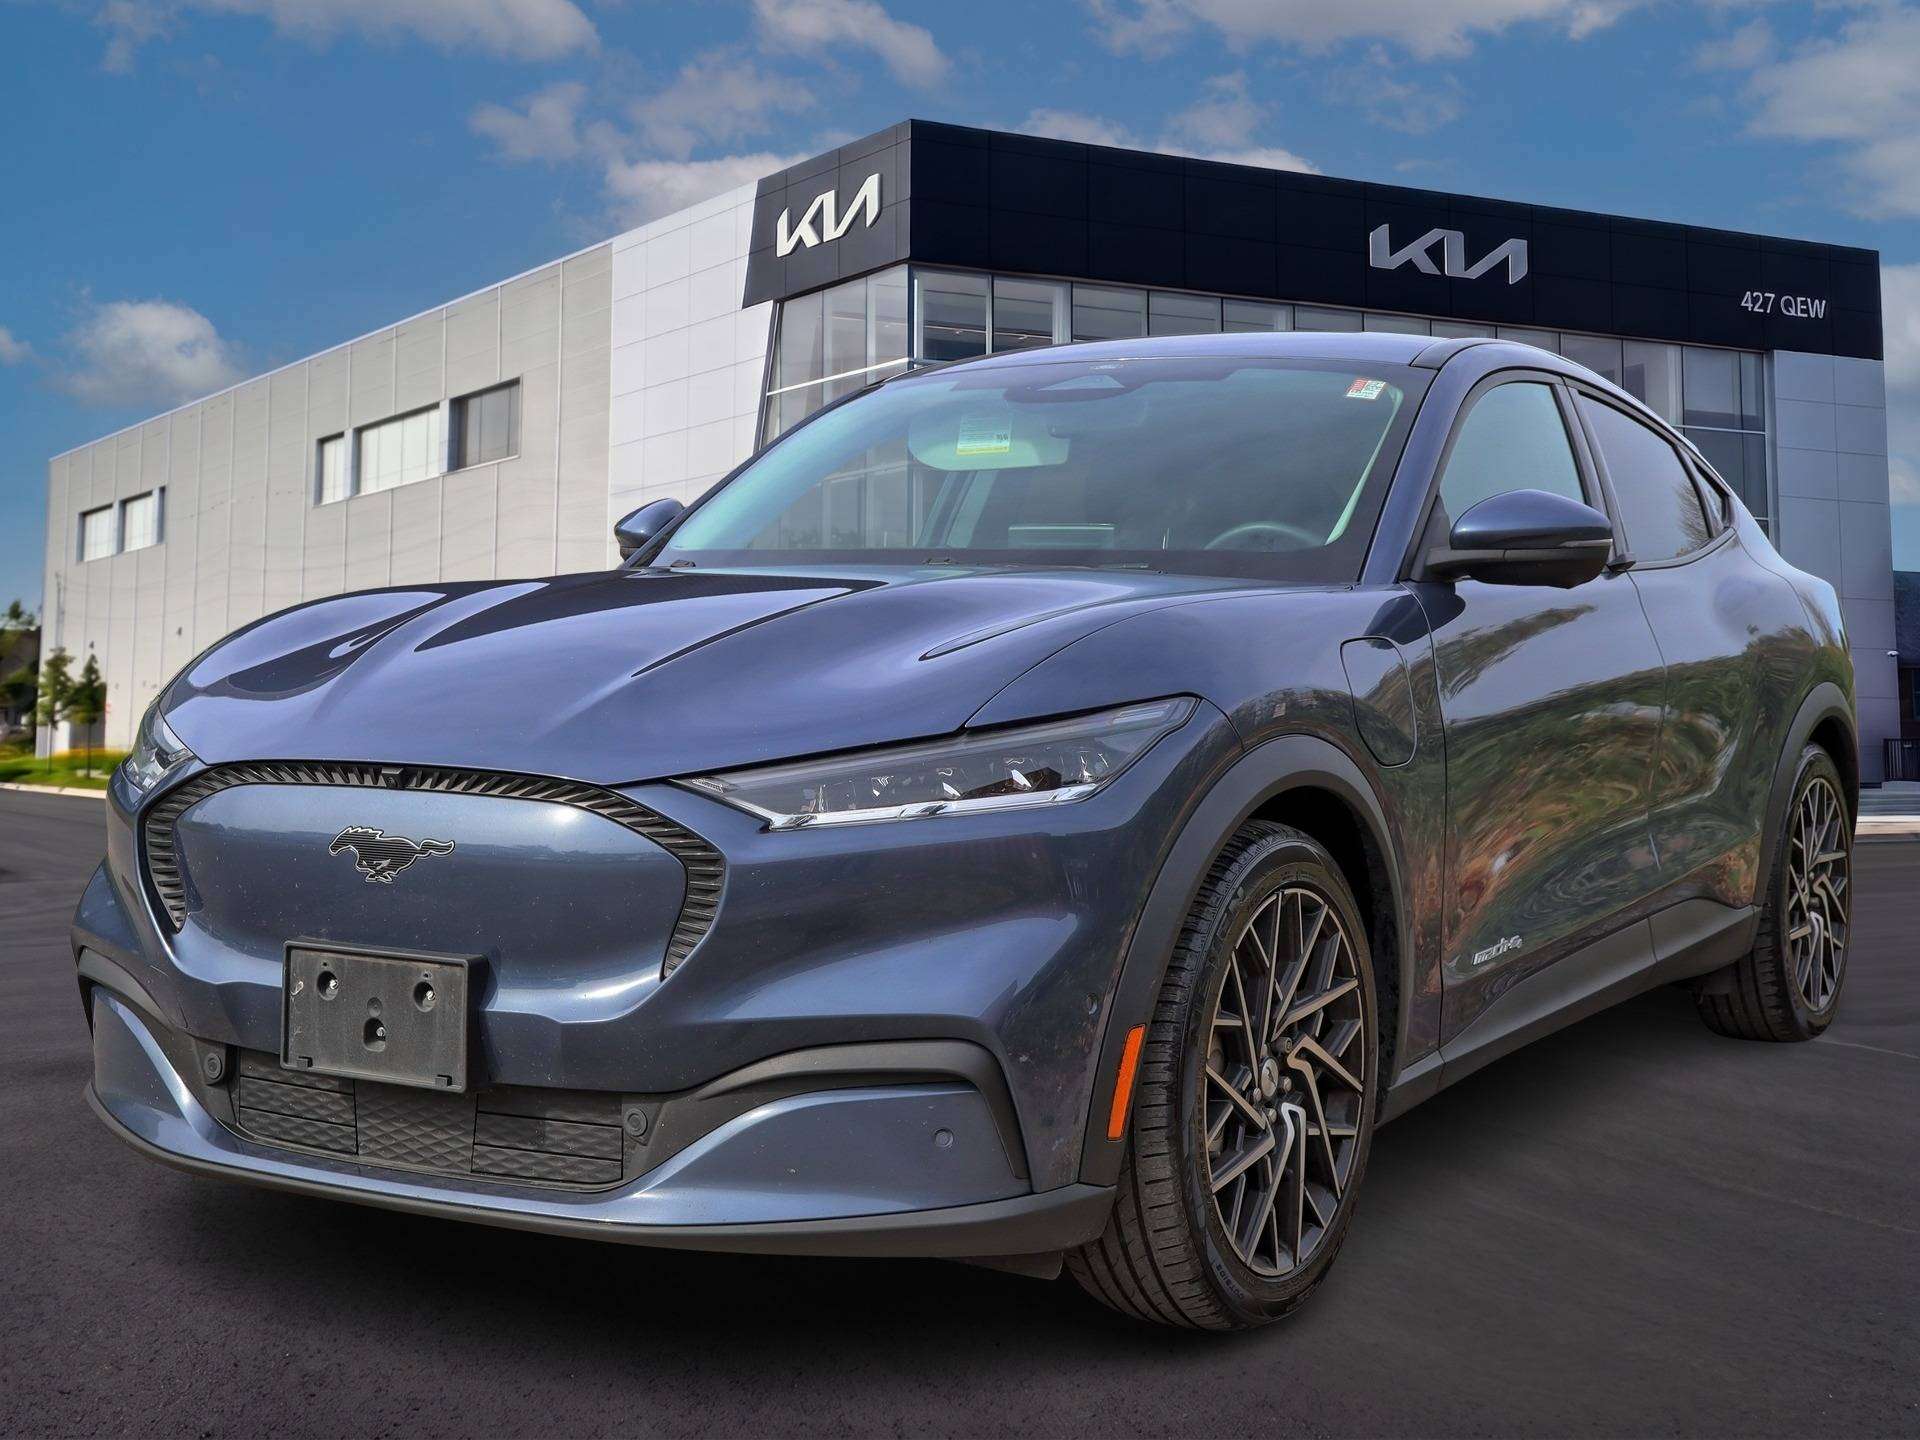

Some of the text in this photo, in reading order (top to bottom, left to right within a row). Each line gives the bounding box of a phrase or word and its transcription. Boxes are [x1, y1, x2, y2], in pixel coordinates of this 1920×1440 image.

[776, 172, 882, 258] KIA
[1369, 223, 1528, 285] KIA
[1740, 291, 1826, 319] 427 QEW
